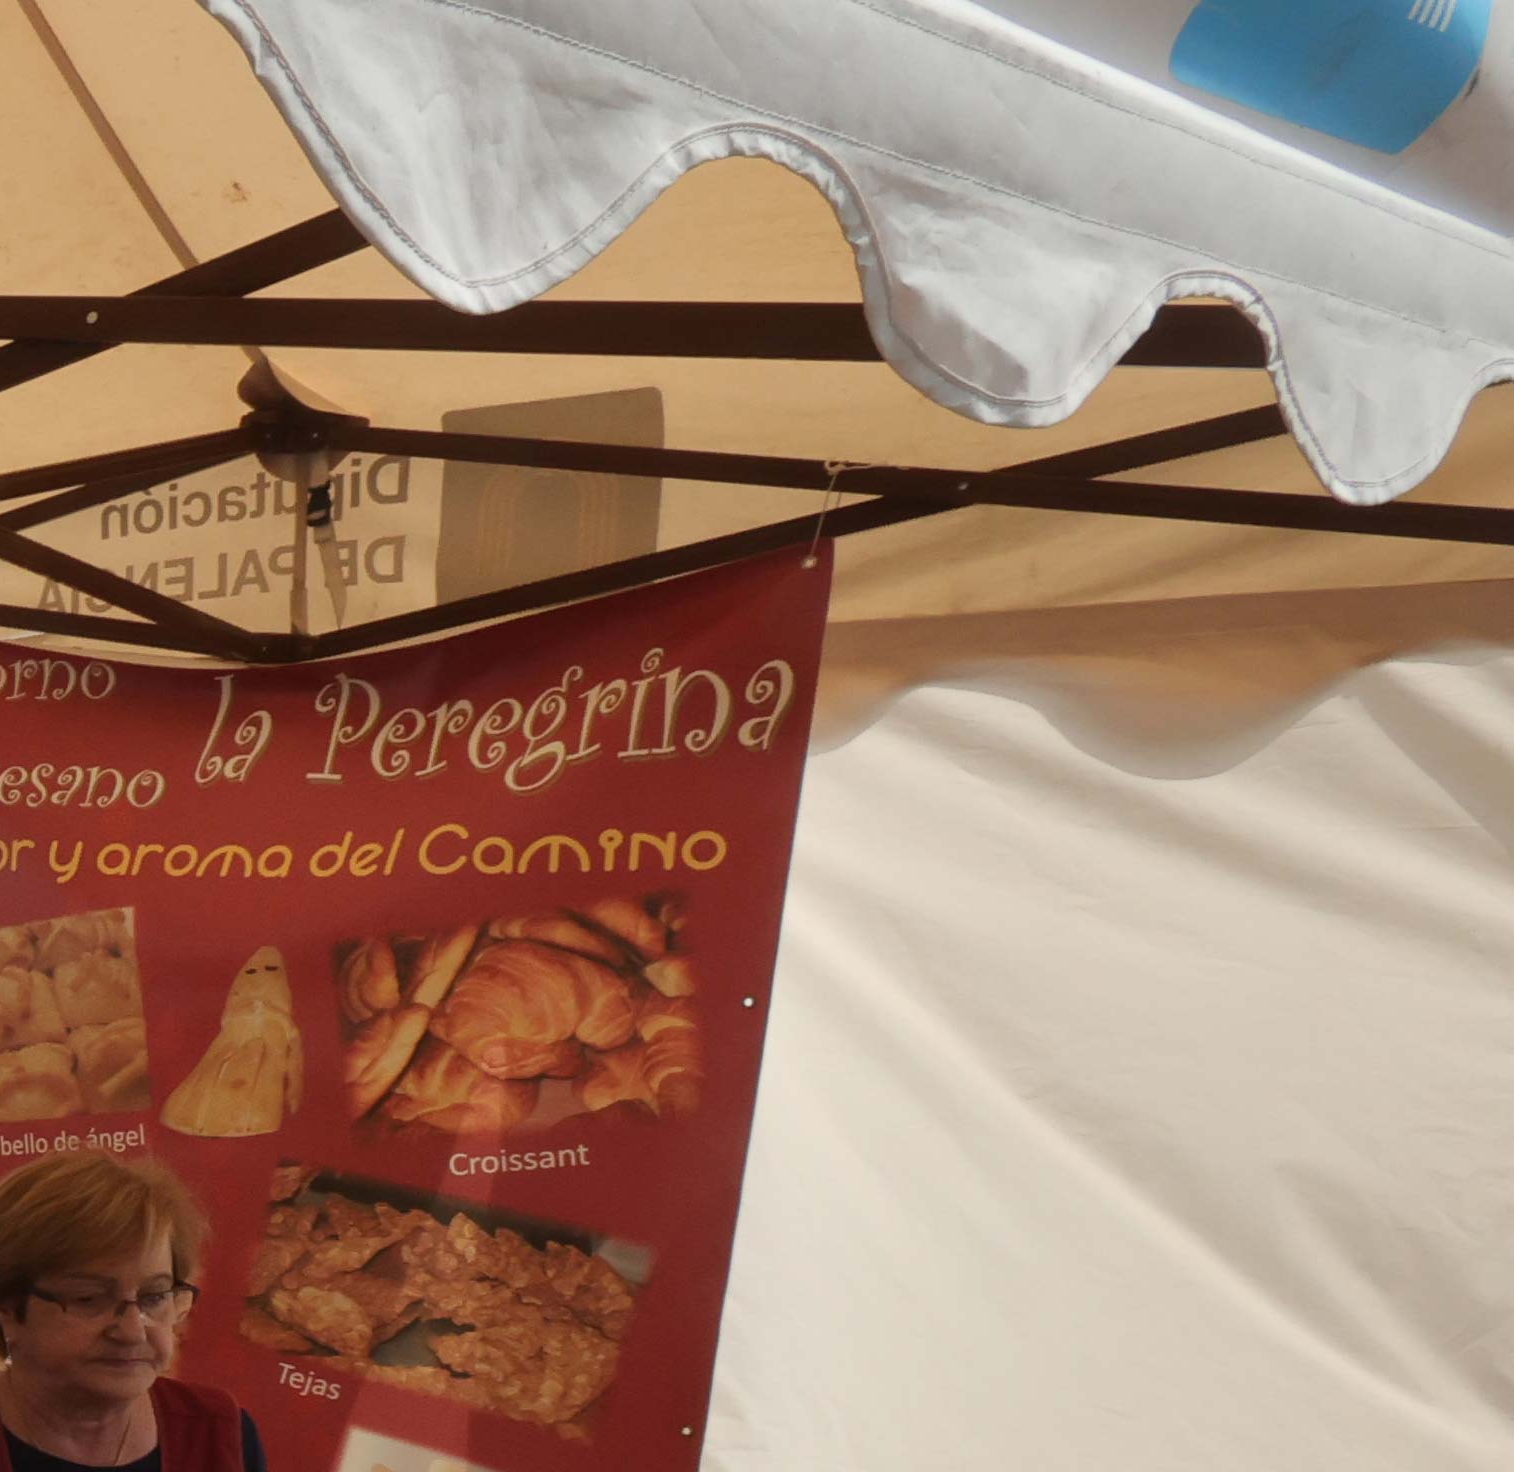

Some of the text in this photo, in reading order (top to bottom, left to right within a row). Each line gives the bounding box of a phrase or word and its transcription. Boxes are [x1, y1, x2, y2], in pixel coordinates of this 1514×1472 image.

[306, 647, 795, 793] Peregrina
[49, 839, 83, 884] y
[96, 841, 293, 879] aroma
[308, 827, 405, 877] del
[54, 1130, 78, 1151] de
[86, 1123, 145, 1152] ángel
[449, 1143, 590, 1176] Croissant
[278, 1362, 342, 1400] Tejas
